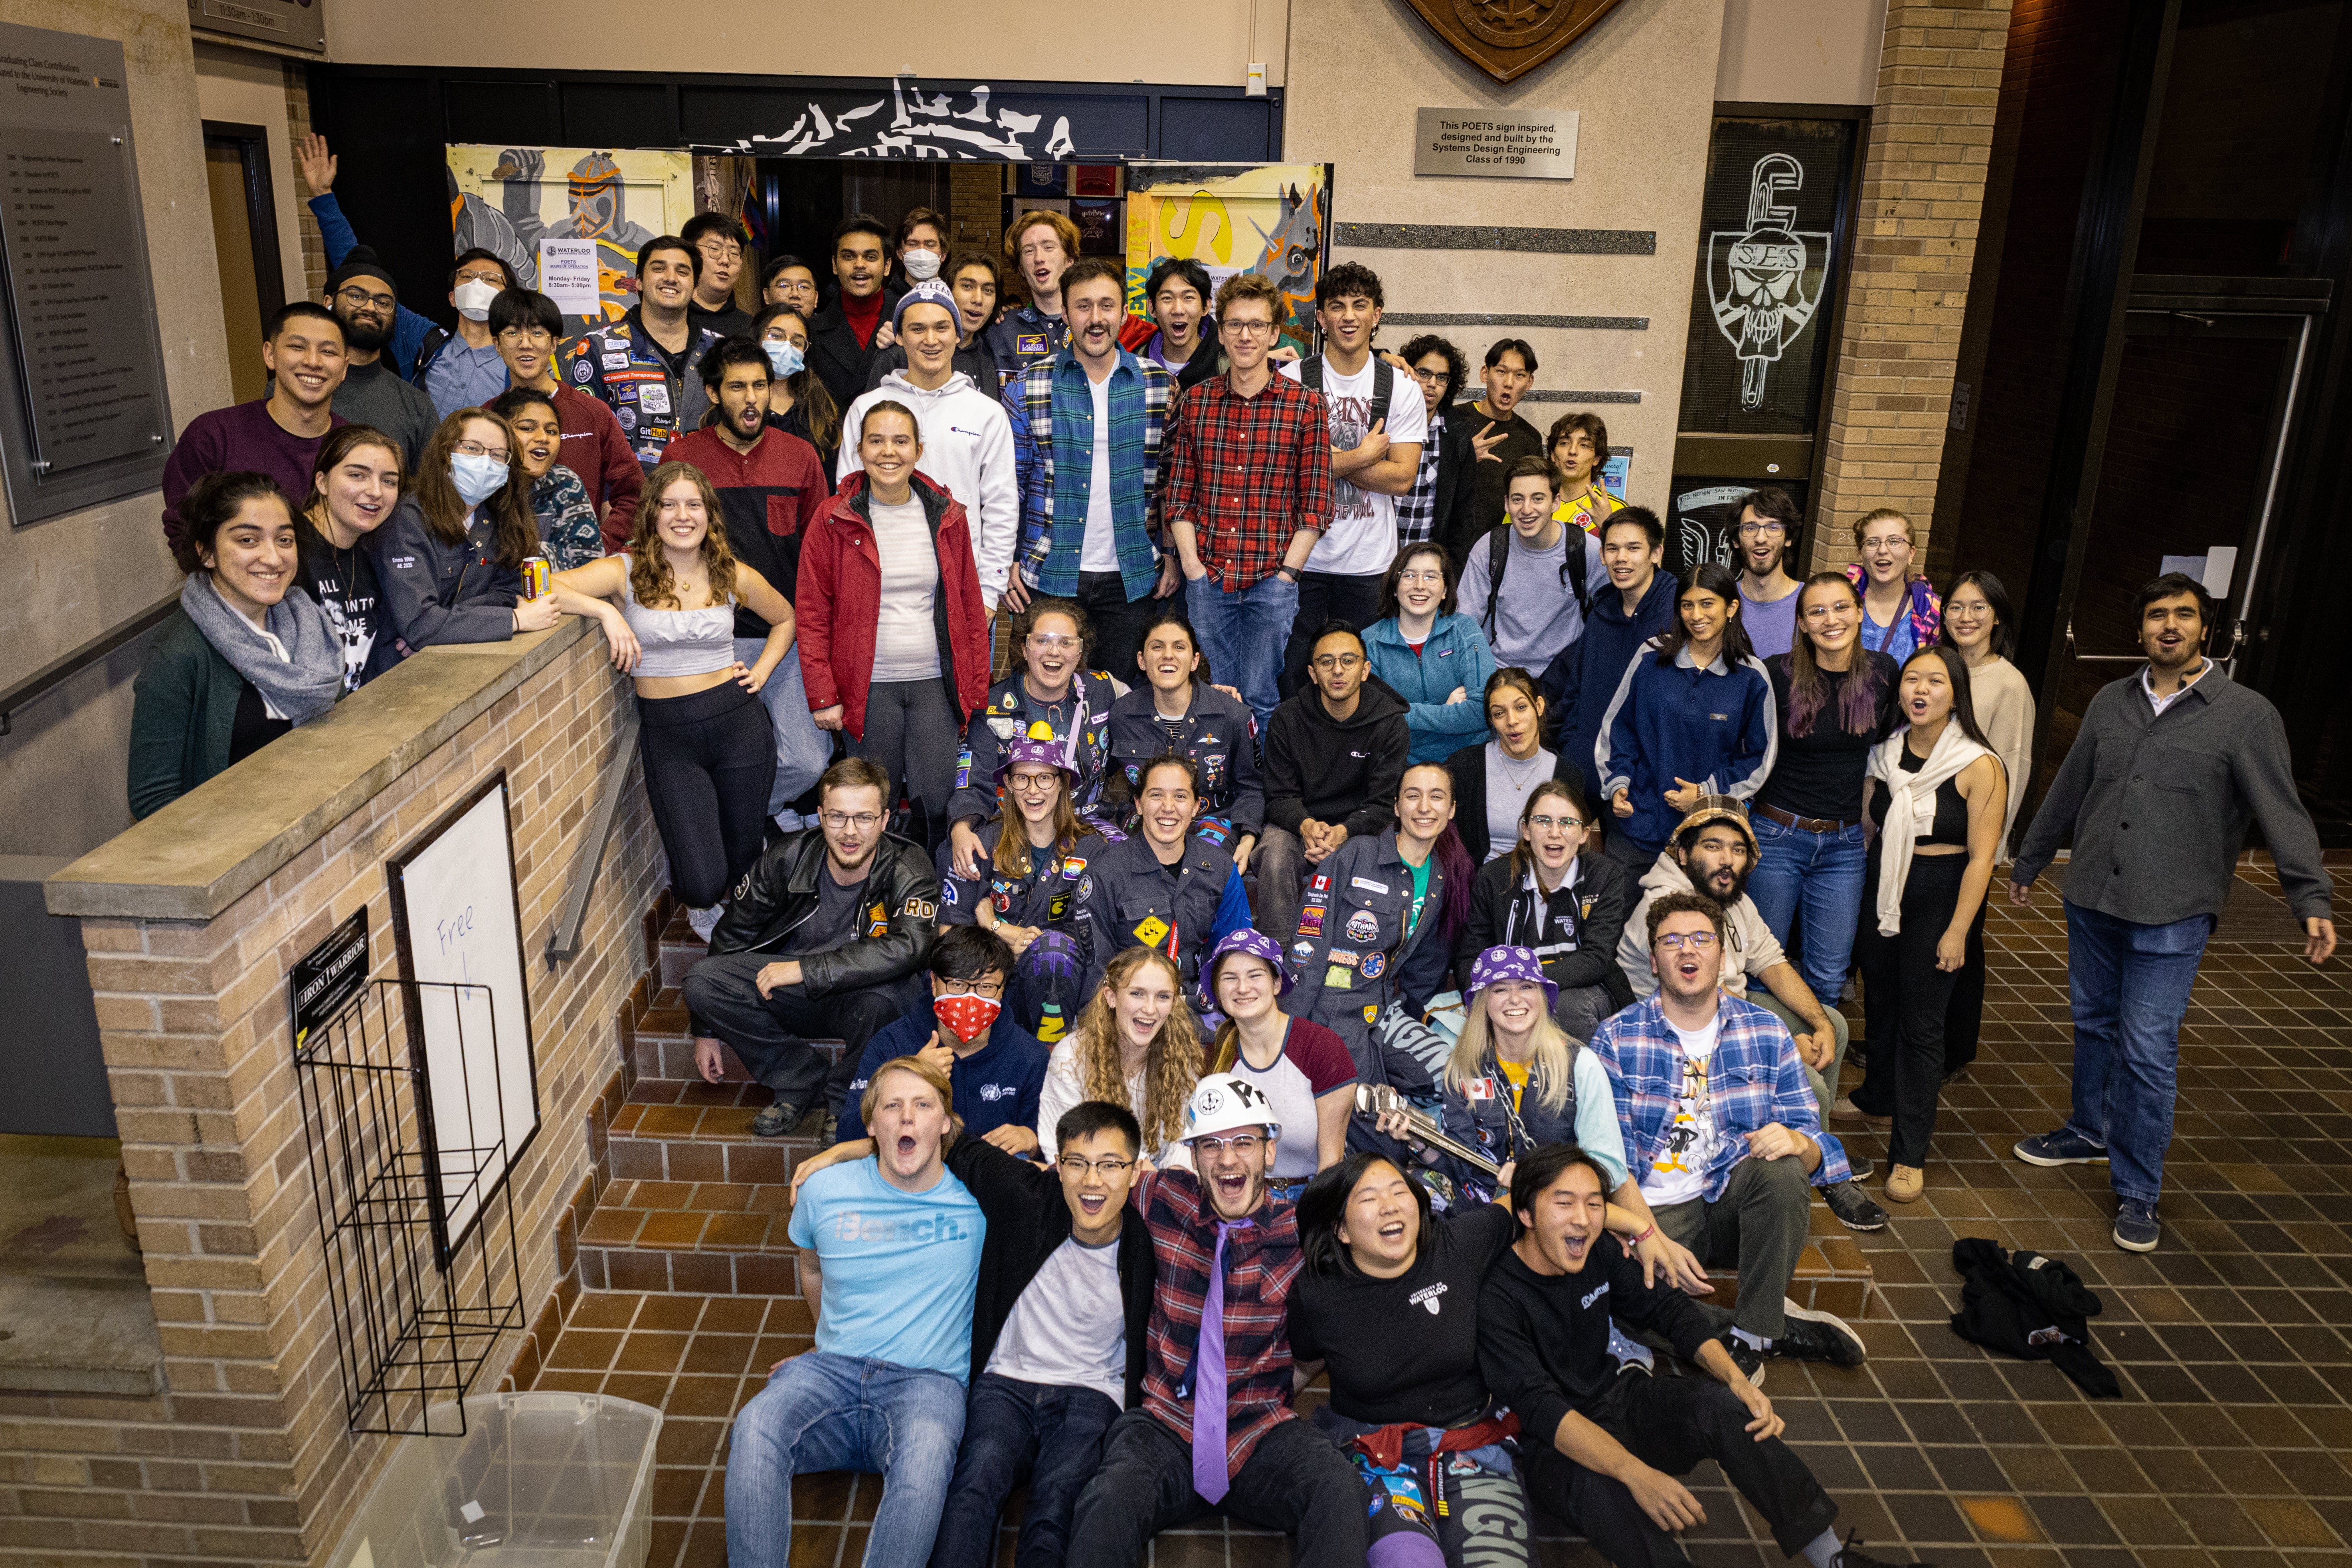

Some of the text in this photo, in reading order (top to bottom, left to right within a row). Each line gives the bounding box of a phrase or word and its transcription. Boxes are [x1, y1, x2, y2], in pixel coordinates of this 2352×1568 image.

[220, 4, 246, 20] 11:30am
[251, 11, 275, 27] 1:30pm
[28, 58, 43, 68] Class
[22, 70, 31, 79] the
[32, 71, 59, 84] University
[16, 83, 68, 99] Engineering Society
[1440, 121, 1556, 133] This POETS sign inspired,
[1441, 132, 1482, 142] designed
[1484, 133, 1501, 142] and
[1503, 134, 1523, 142] built
[1526, 134, 1537, 144] by
[1432, 143, 1561, 156] Systems Design Engineering
[1466, 154, 1491, 163] Class
[951, 427, 981, 437] Champion
[318, 579, 339, 593] ALL
[348, 617, 367, 633] ME
[437, 906, 473, 956] Free
[1349, 919, 1376, 931] MOTHMAN
[304, 975, 325, 1004] IRON
[330, 937, 364, 976] WARRIOR
[834, 1210, 968, 1242] Bench.
[1409, 1284, 1448, 1305] WATERLOO
